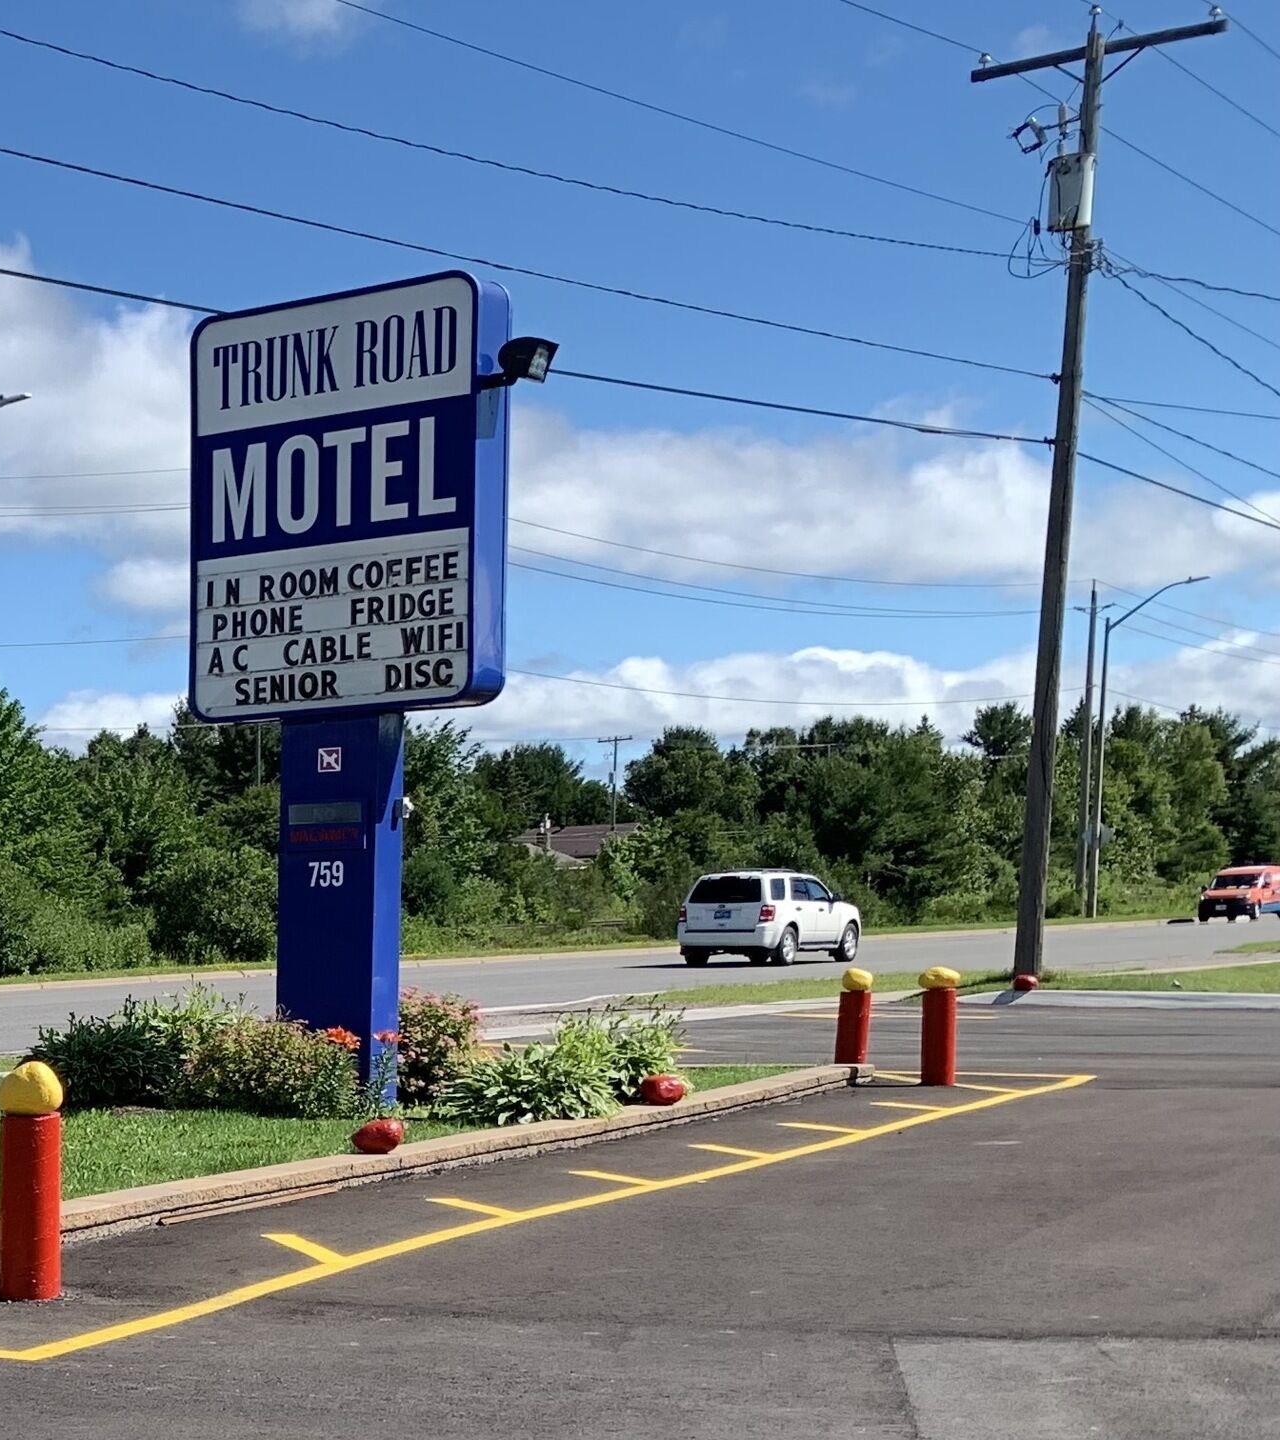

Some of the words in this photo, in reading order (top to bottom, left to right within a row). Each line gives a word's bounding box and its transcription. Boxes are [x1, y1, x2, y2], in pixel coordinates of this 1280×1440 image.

[213, 325, 339, 411] TRUNK
[353, 305, 458, 389] ROAD
[211, 416, 457, 544] MOTEL
[259, 566, 339, 602] ROOM
[347, 551, 459, 591] COFFEE
[212, 605, 303, 640] PHONE
[351, 588, 454, 626] FRIDGE
[283, 632, 371, 667] CABLE
[401, 621, 464, 655] WIFI
[235, 670, 339, 705] SENIOR
[385, 658, 454, 692] DISC
[308, 861, 344, 888] 759
